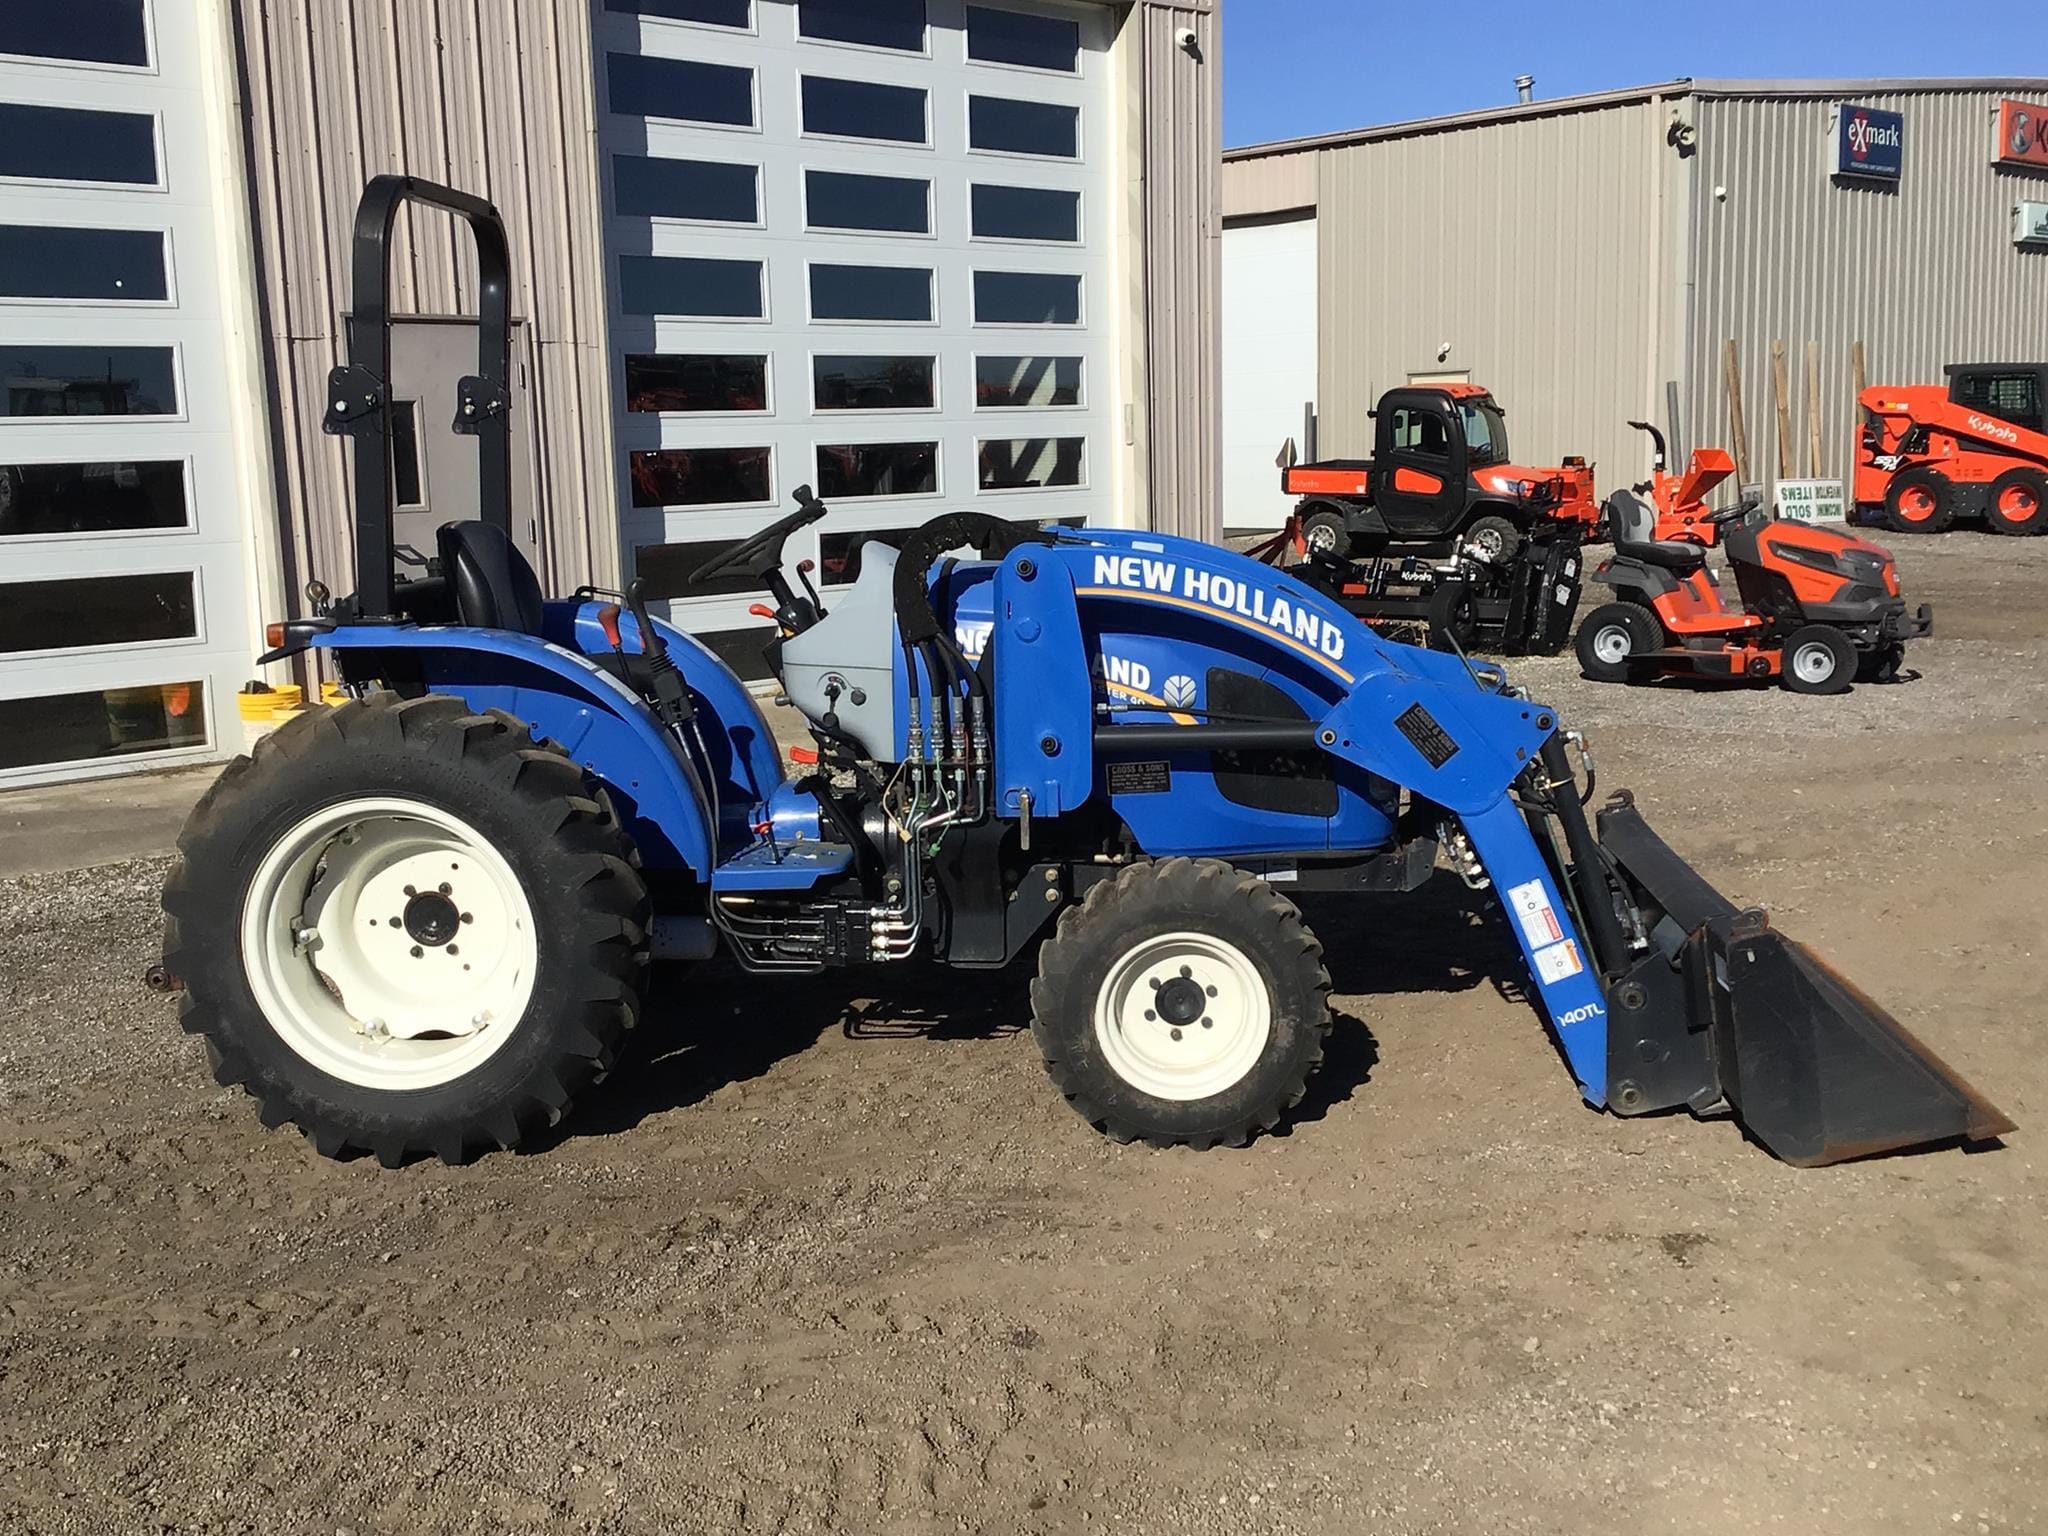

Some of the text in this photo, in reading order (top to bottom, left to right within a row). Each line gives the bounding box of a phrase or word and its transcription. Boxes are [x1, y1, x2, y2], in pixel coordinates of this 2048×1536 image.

[1848, 118, 1899, 153] eXmark
[2036, 117, 2048, 153] K
[1967, 414, 2018, 444] Kubota
[1781, 487, 1813, 500] ITEMS
[1785, 504, 1812, 518] SOLD
[1401, 571, 1432, 581] Kubota
[1094, 555, 1345, 661] NEW HOLLAND
